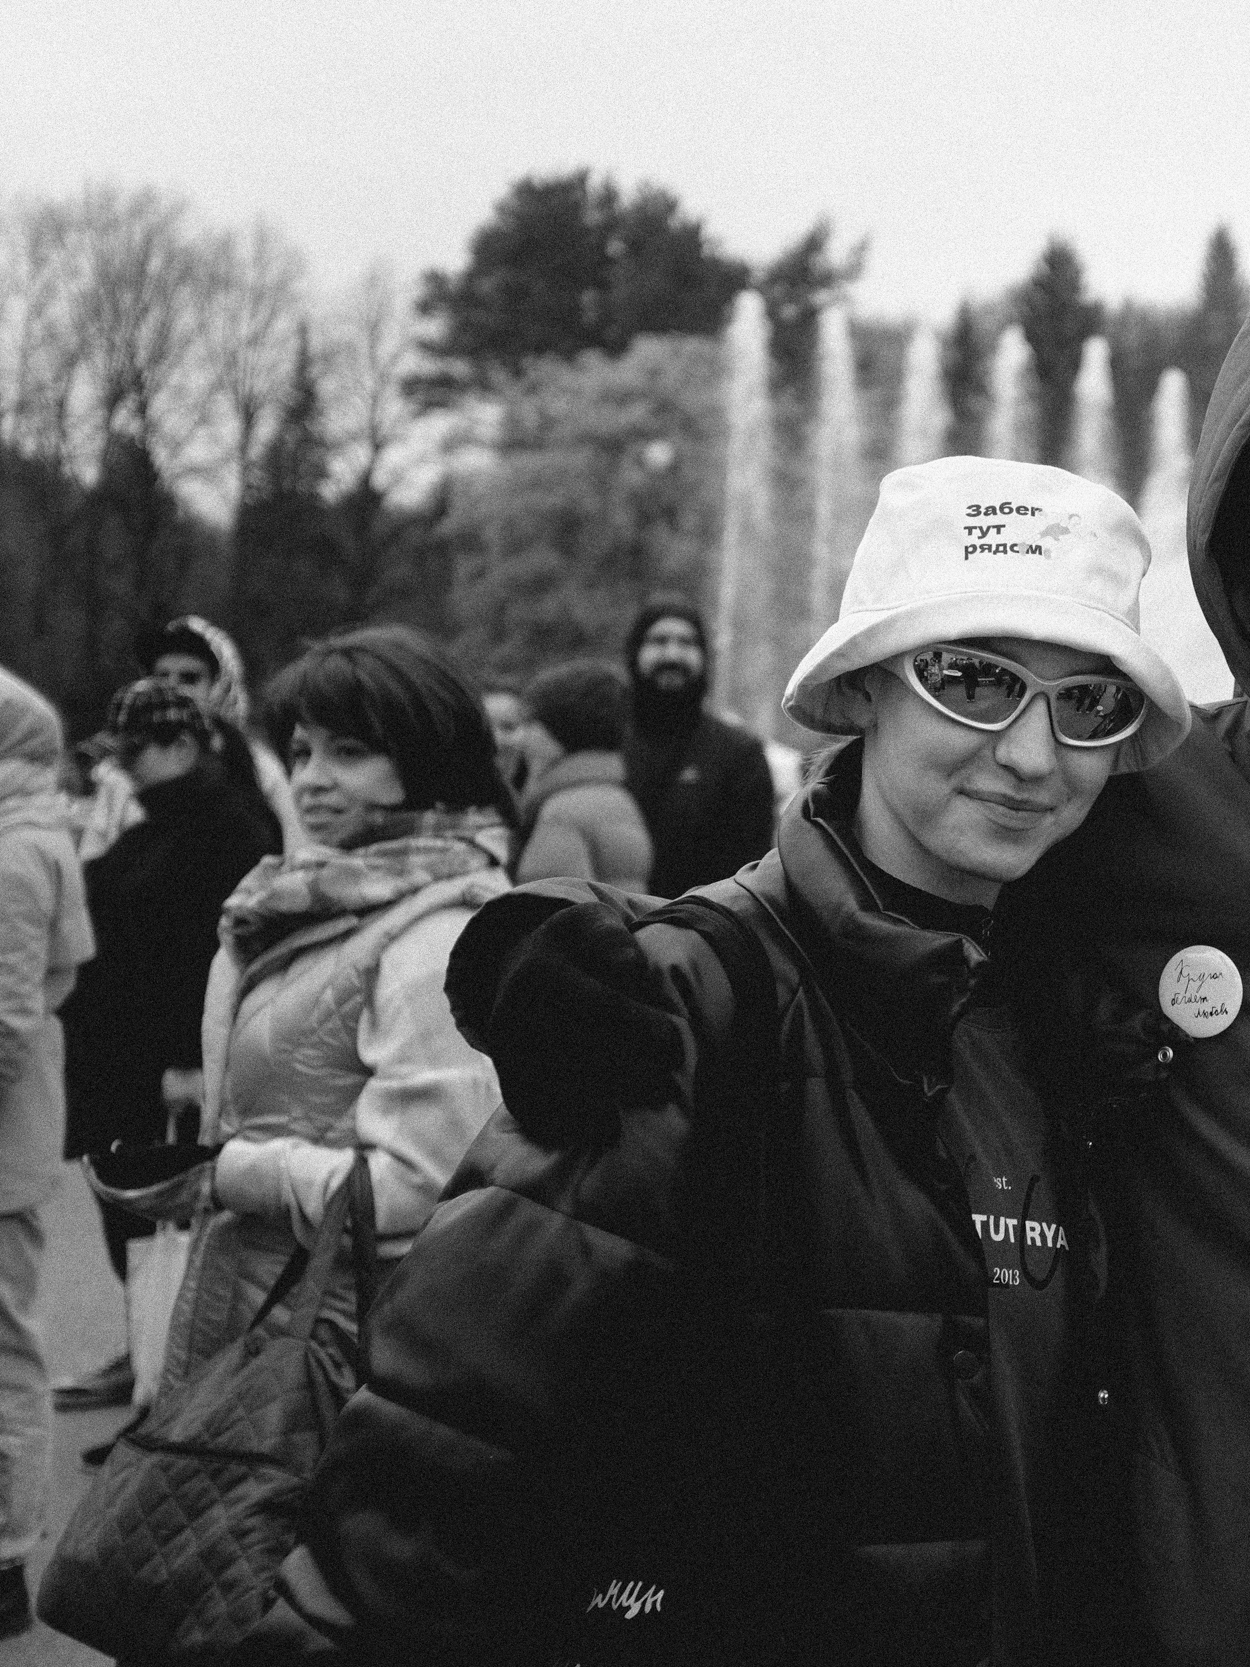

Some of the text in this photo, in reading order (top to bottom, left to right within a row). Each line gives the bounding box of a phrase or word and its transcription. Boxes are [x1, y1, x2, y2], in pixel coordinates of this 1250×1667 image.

[965, 501, 1043, 518] Забег
[964, 524, 1006, 540] тут
[964, 542, 1043, 561] рядом
[971, 1213, 1018, 1243] TUT
[993, 1267, 1020, 1285] 2013
